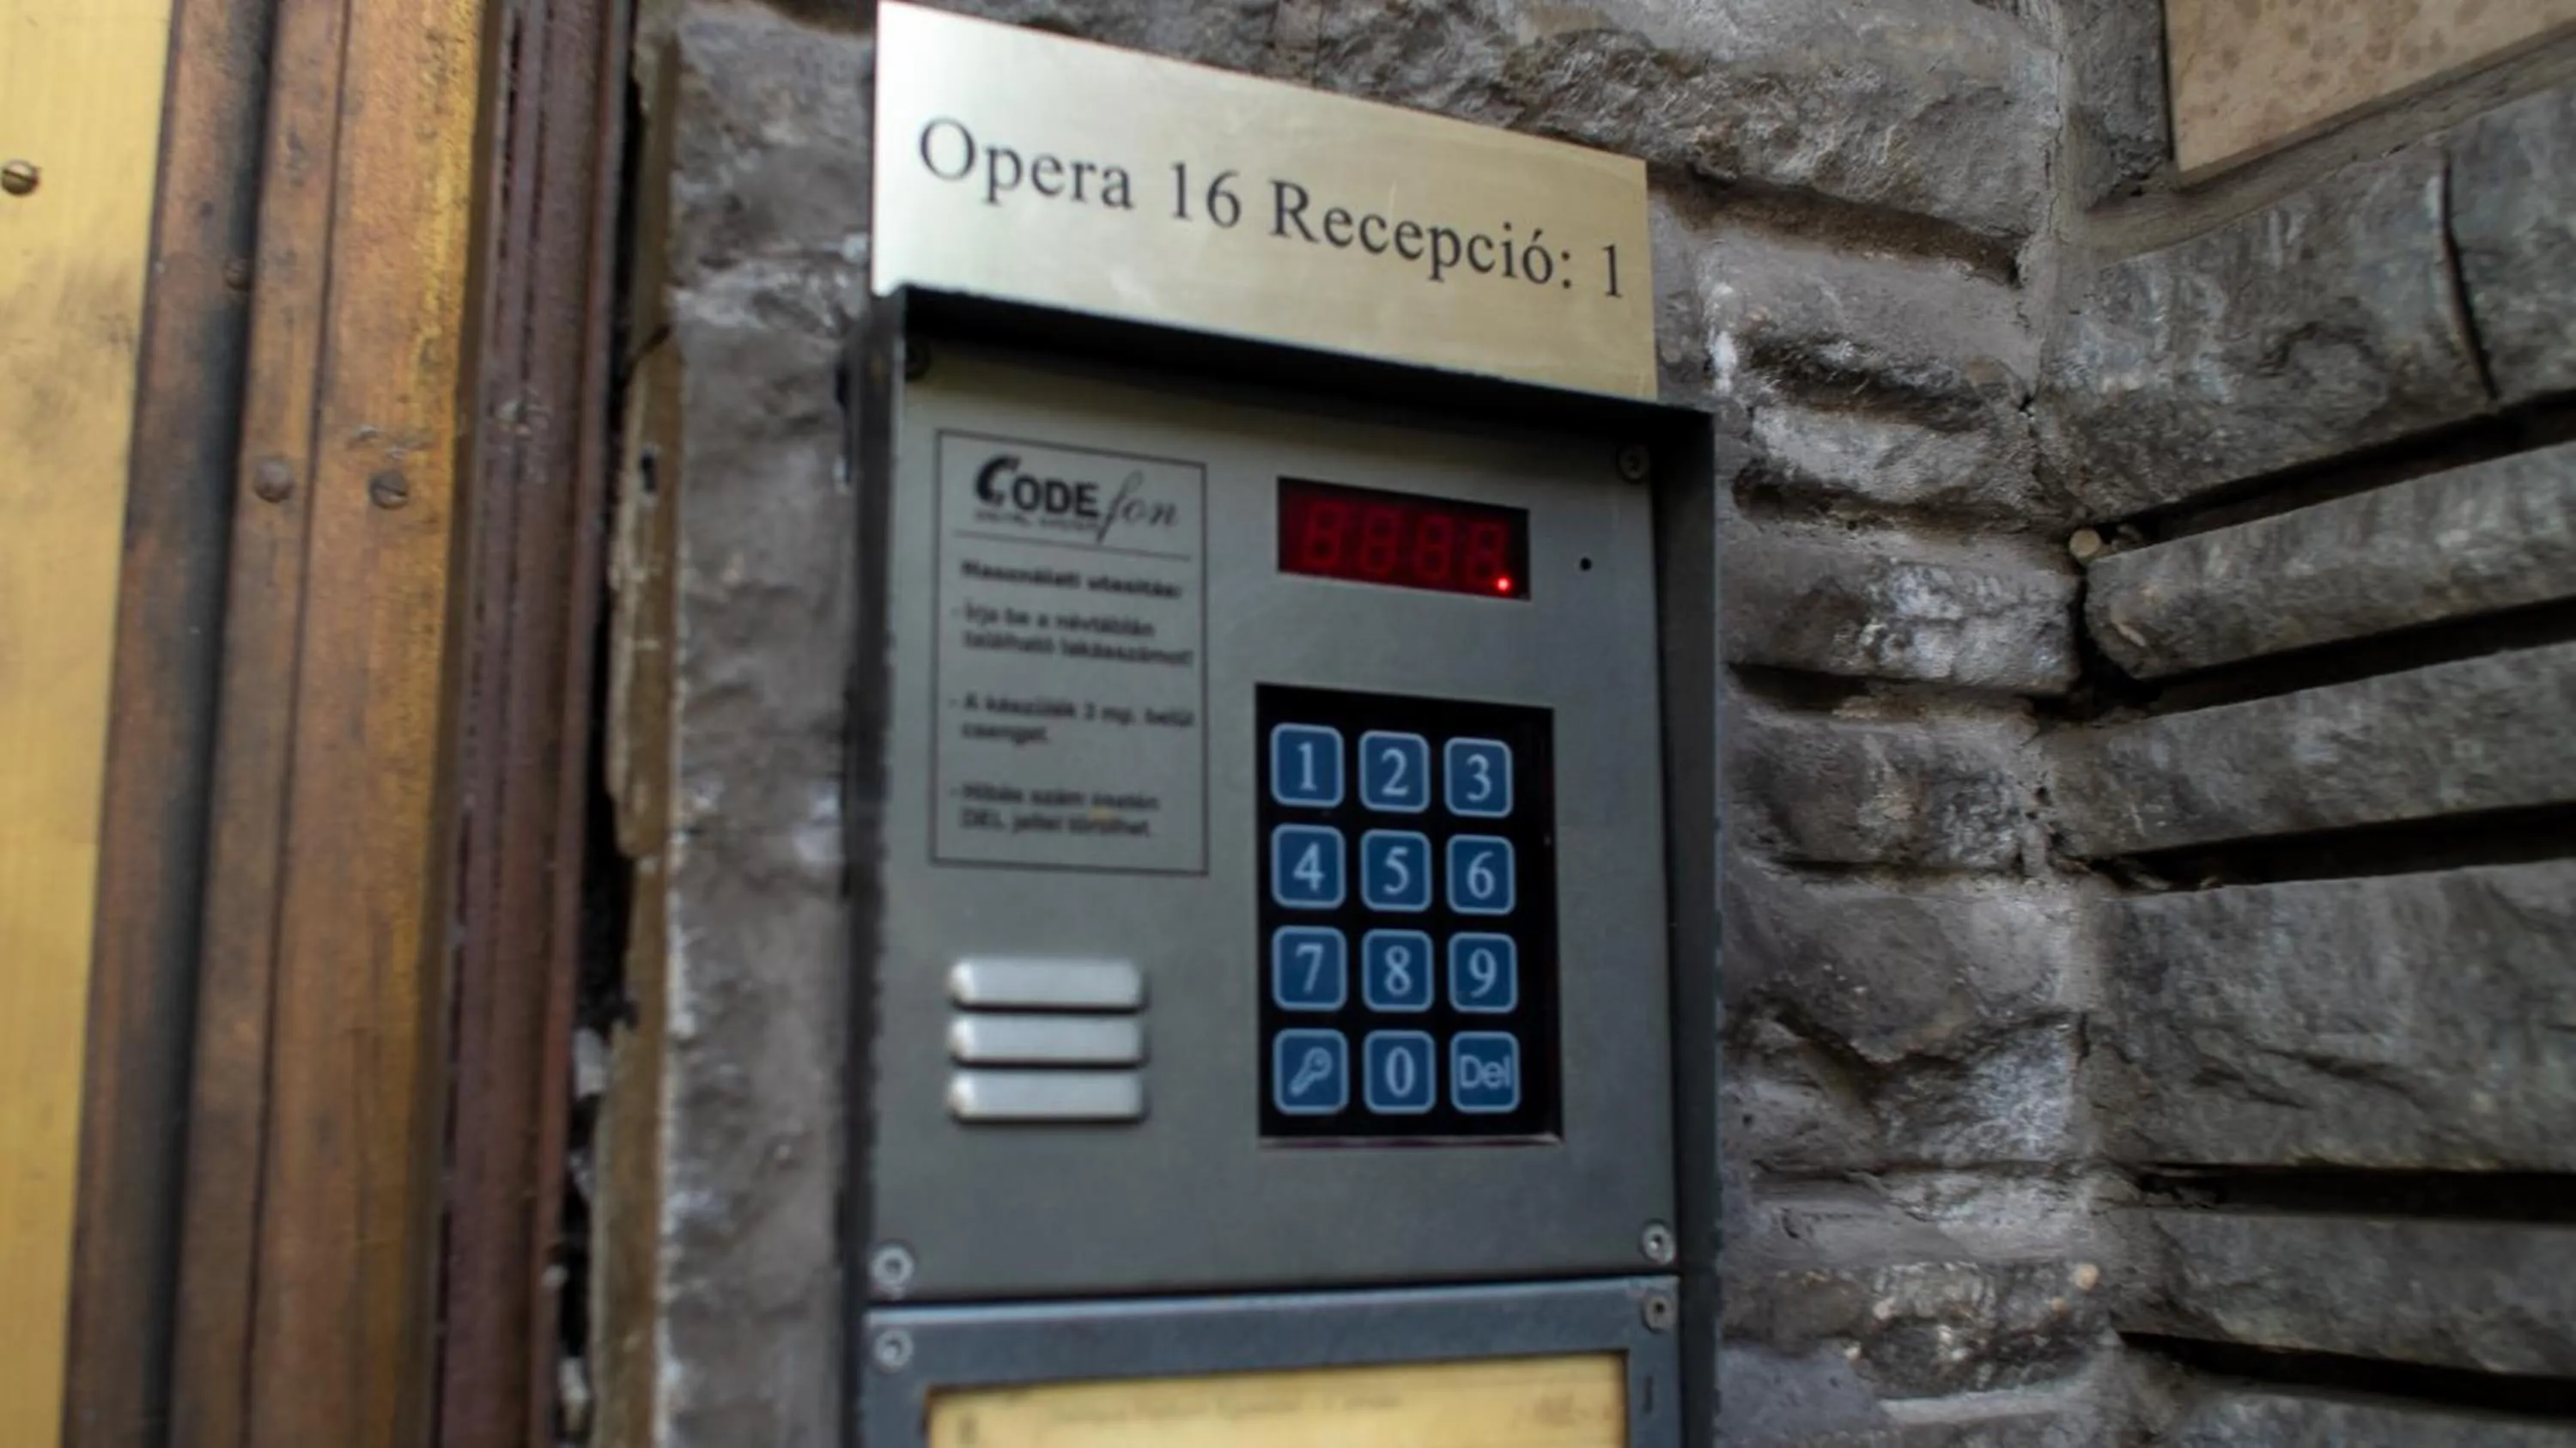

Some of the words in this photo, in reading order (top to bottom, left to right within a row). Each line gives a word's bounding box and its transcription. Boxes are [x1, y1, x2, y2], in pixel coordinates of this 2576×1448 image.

[919, 118, 1134, 210] Opera
[1170, 162, 1242, 228] 16
[1269, 179, 1572, 288] Recepció:
[1602, 245, 1623, 298] 1
[1295, 741, 1318, 792] 1
[1380, 748, 1409, 797] 2
[1466, 753, 1492, 801] 3
[1293, 842, 1325, 892] 4
[1383, 846, 1410, 895] 5
[1467, 851, 1495, 899] 6
[1295, 943, 1324, 994] 7
[1384, 945, 1413, 996] 8
[1468, 948, 1498, 998] 9
[1385, 1046, 1416, 1098] 0
[1460, 1054, 1512, 1090] Del
